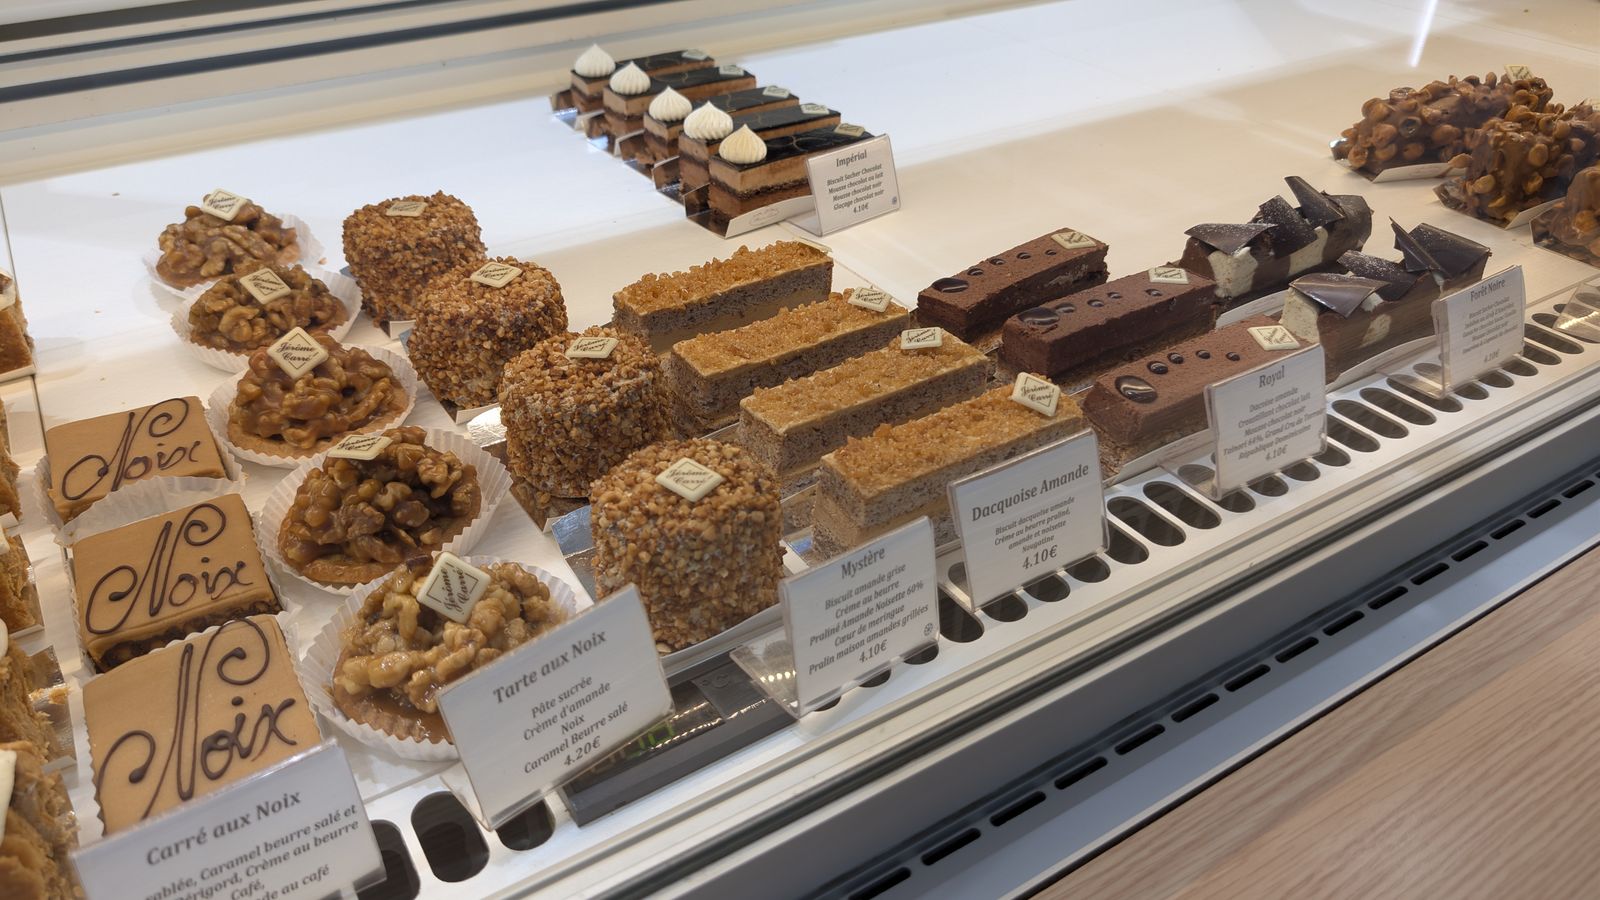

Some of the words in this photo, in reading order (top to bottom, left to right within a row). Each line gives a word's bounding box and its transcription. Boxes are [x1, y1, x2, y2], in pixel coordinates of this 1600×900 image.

[836, 149, 867, 167] Impérial
[847, 178, 867, 188] chocolat
[851, 185, 872, 196] chocolat
[853, 193, 874, 204] chocolat
[1470, 285, 1487, 302] Forêt
[1488, 279, 1506, 294] Noire
[1259, 365, 1285, 388] Royal
[1266, 444, 1288, 461] 4.10€
[972, 486, 1038, 521] Dacquoise
[1039, 463, 1089, 495] Amande
[994, 532, 1015, 546] Crème
[1015, 529, 1024, 537] au
[1024, 519, 1046, 533] beurre
[995, 521, 1017, 536] Biscuit
[1018, 508, 1049, 526] dacquoise
[1050, 496, 1075, 512] amande
[1008, 533, 1033, 550] amande
[1034, 530, 1041, 538] et
[1041, 520, 1067, 535] noisette
[1022, 535, 1055, 552] Nougatine
[86, 503, 254, 635] Noix
[841, 547, 886, 579] Mystère
[1022, 544, 1058, 570] 4.10€
[825, 591, 853, 611] Biscuit
[854, 573, 886, 597] amande
[887, 563, 907, 583] grise
[835, 600, 861, 620] Crème
[862, 594, 873, 606] au
[874, 580, 900, 601] beurre
[809, 624, 841, 647] Praliné
[841, 606, 874, 631] Amande
[875, 591, 906, 612] Noisette
[906, 580, 924, 596] 60%
[834, 629, 857, 647] Cœur
[857, 621, 867, 636] de
[868, 604, 905, 633] meringue
[809, 652, 835, 675] Pralin
[836, 639, 866, 661] maison
[866, 620, 901, 646] amandes
[901, 604, 929, 628] grillées
[858, 639, 888, 663] 4.10€
[492, 670, 538, 705] Tarte
[541, 655, 570, 678] aux
[571, 629, 608, 660] Noix
[523, 715, 558, 743] Crème
[559, 681, 612, 721] d'amande
[531, 696, 557, 719] Pâte
[558, 676, 593, 703] sucrée
[96, 617, 298, 820] Noix
[560, 714, 586, 735] Noix
[524, 739, 570, 774] Caramel
[571, 717, 607, 745] Beurre
[607, 701, 629, 723] salé
[563, 735, 602, 767] 4.20€
[146, 826, 208, 867] Carré
[213, 812, 252, 839] aux
[255, 790, 301, 822] Noix
[200, 846, 261, 881] Caramel
[263, 828, 312, 857] beurre
[314, 809, 342, 832] salé
[343, 804, 357, 817] et
[245, 851, 290, 878] Crème
[293, 843, 311, 857] au
[314, 819, 359, 849] beurre
[281, 883, 300, 896] au
[302, 864, 330, 886] café
